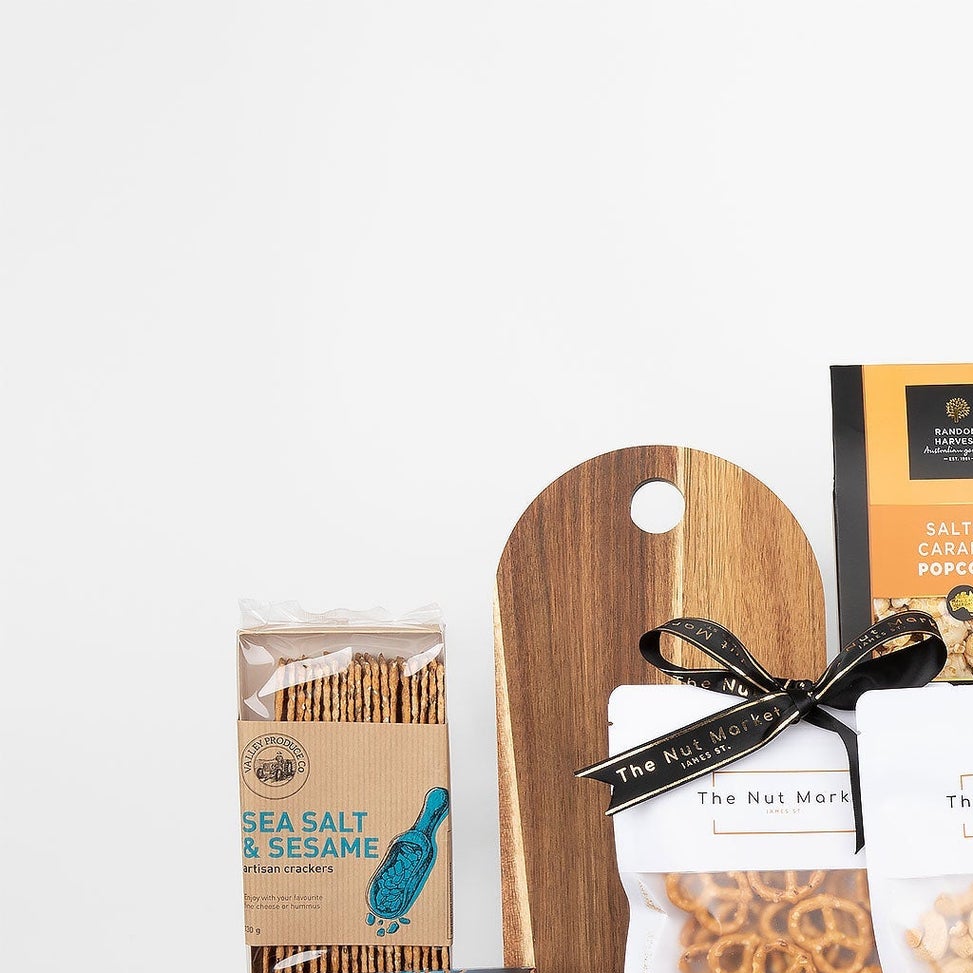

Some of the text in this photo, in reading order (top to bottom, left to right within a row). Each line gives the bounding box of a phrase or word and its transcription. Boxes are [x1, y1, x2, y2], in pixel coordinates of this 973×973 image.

[923, 446, 963, 454] Australian
[243, 739, 263, 774] VALLEY
[264, 736, 305, 760] PRODUCE
[615, 706, 782, 784] The Nut Market
[680, 751, 713, 770] JAMES
[698, 790, 850, 805] The Nut Mark
[242, 811, 368, 833] SEA SALT
[243, 836, 379, 859] & SESAME
[243, 864, 334, 874] artisan crackers
